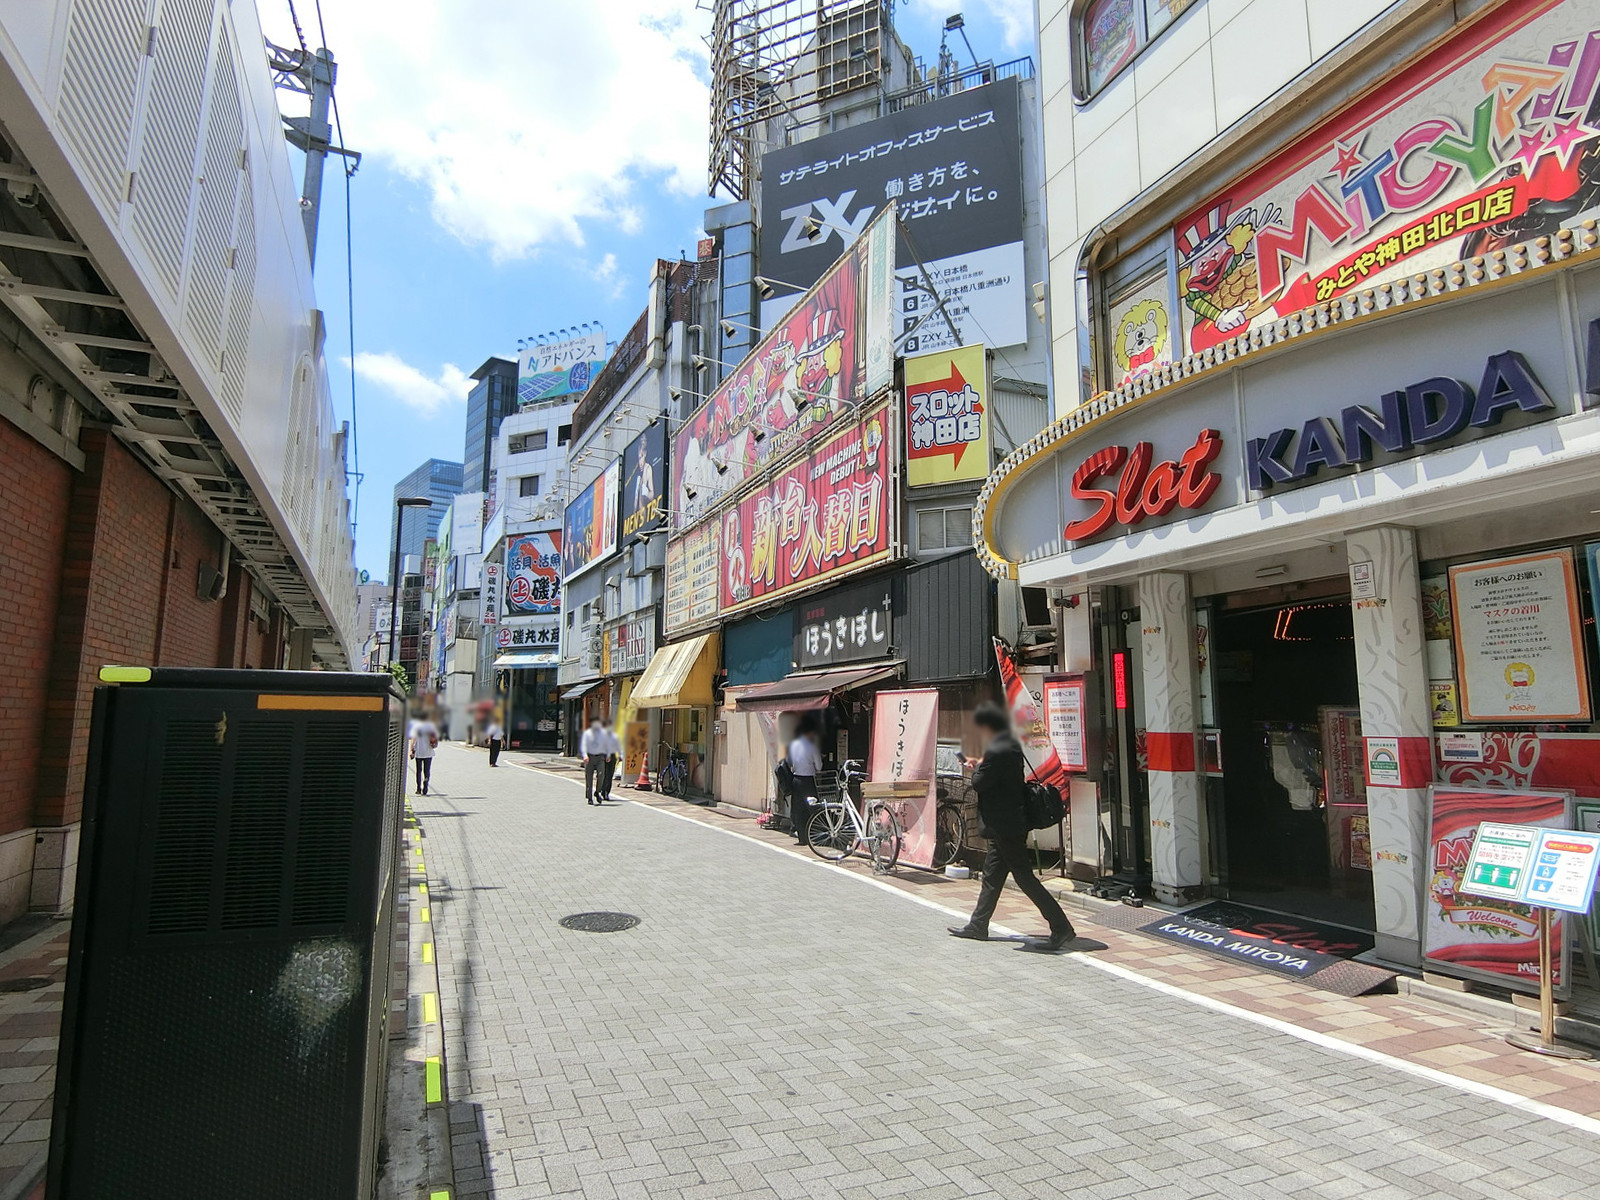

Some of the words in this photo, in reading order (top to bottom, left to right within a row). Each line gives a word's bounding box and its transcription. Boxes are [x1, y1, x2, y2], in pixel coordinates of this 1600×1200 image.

[779, 110, 996, 185] サテライトオフィスサービス
[885, 160, 981, 200] 働き方を、
[780, 189, 876, 254] ZXY
[1316, 187, 1515, 300] みとや神田北口店
[943, 264, 969, 276] 日本橋
[542, 345, 597, 368] アドバンス
[921, 332, 942, 343] ZXY
[909, 384, 981, 423] スロット
[1247, 350, 1557, 492] KANDA
[911, 411, 981, 450] 神田店
[810, 461, 826, 482] NEW
[826, 439, 862, 472] MACHINE
[1063, 428, 1224, 542] Slot
[750, 472, 884, 586] 新台入替日
[511, 552, 560, 571] 活貝・活魚
[1474, 571, 1543, 587] お客様へのお願い
[486, 577, 496, 613] 磯丸水産
[1483, 604, 1540, 618] マスクの着用
[512, 626, 560, 645] 磯丸水産
[806, 606, 885, 657] ほうきぼし
[891, 699, 909, 781] ほうきぼ
[1466, 909, 1519, 930] Welcome
[1158, 923, 1225, 947] KANDA
[1224, 941, 1310, 970] MITOYA
